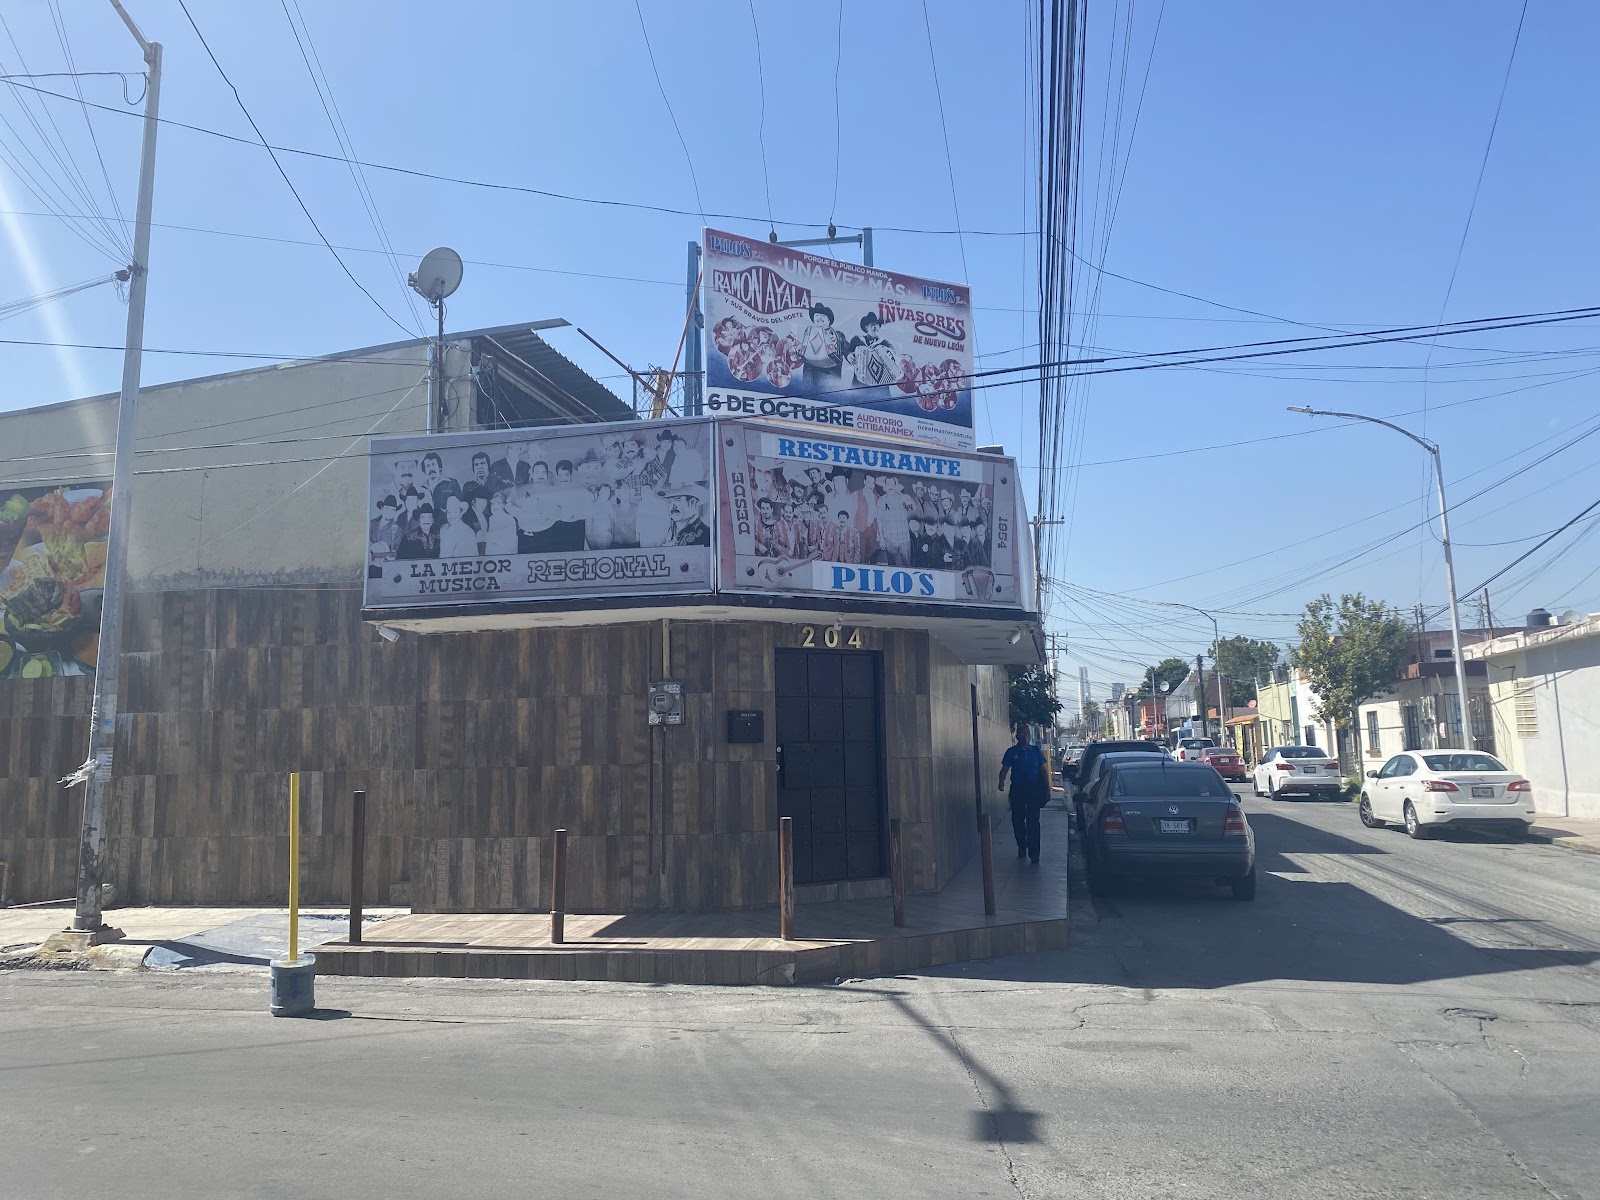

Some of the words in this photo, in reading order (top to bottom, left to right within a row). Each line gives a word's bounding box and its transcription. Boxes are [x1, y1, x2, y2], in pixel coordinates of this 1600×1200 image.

[803, 254, 830, 266] PORQUE
[714, 267, 763, 313] RAMON
[765, 271, 811, 312] AYALA
[784, 257, 825, 281] UNA
[829, 268, 864, 290] VEZ
[868, 278, 906, 298] MÁS
[731, 300, 743, 311] SUS
[743, 309, 770, 324] BRAVOS
[783, 312, 804, 321] NORTE
[880, 297, 900, 307] LOS
[878, 303, 966, 341] INVASORES
[913, 335, 923, 344] DE
[924, 337, 947, 349] NUEVO
[947, 340, 965, 353] LEÓN
[707, 393, 721, 411] 6
[726, 394, 756, 414] DE
[760, 399, 854, 427] OCTUBRE
[856, 413, 903, 428] AUDITORIO
[856, 421, 914, 438] CITIBANAMEX
[778, 437, 961, 477] RESTAURANTE
[732, 472, 751, 535] DESDE
[997, 516, 1009, 549] 1954
[410, 563, 436, 577] LA
[441, 559, 512, 576] MEJOR
[527, 554, 671, 583] REGIONAL
[419, 576, 501, 594] MUSICA
